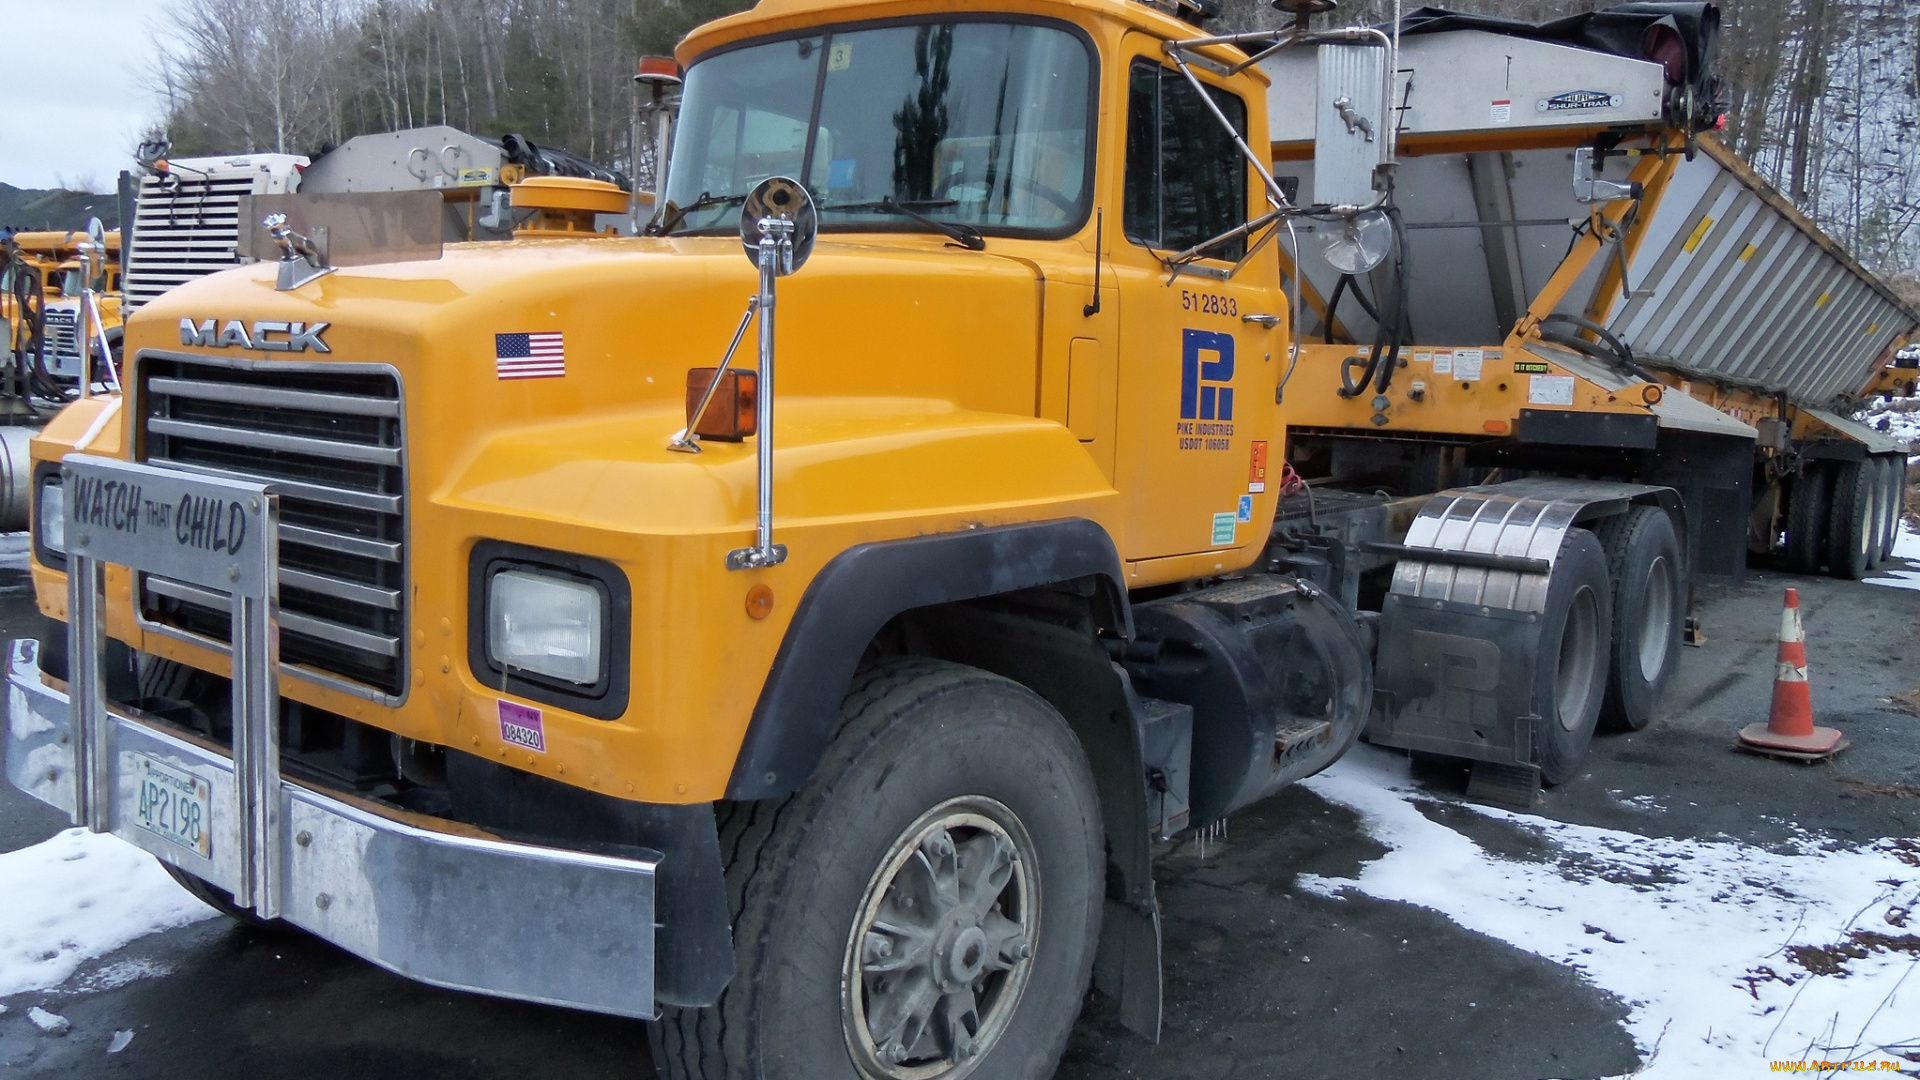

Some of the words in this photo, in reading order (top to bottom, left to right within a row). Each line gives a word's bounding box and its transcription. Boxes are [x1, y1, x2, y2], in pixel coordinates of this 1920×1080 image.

[835, 49, 843, 62] 3
[1549, 100, 1609, 110] SHUR-TRAK
[180, 318, 331, 353] MACK
[1177, 422, 1193, 435] PIKE
[1196, 423, 1234, 436] INDUSTRIES
[1180, 438, 1203, 450] USDOT
[74, 475, 142, 534] WATCH
[145, 500, 172, 529] THAT
[176, 493, 246, 555] CHILD
[505, 723, 540, 748] 084320
[139, 780, 201, 843] AP2198
